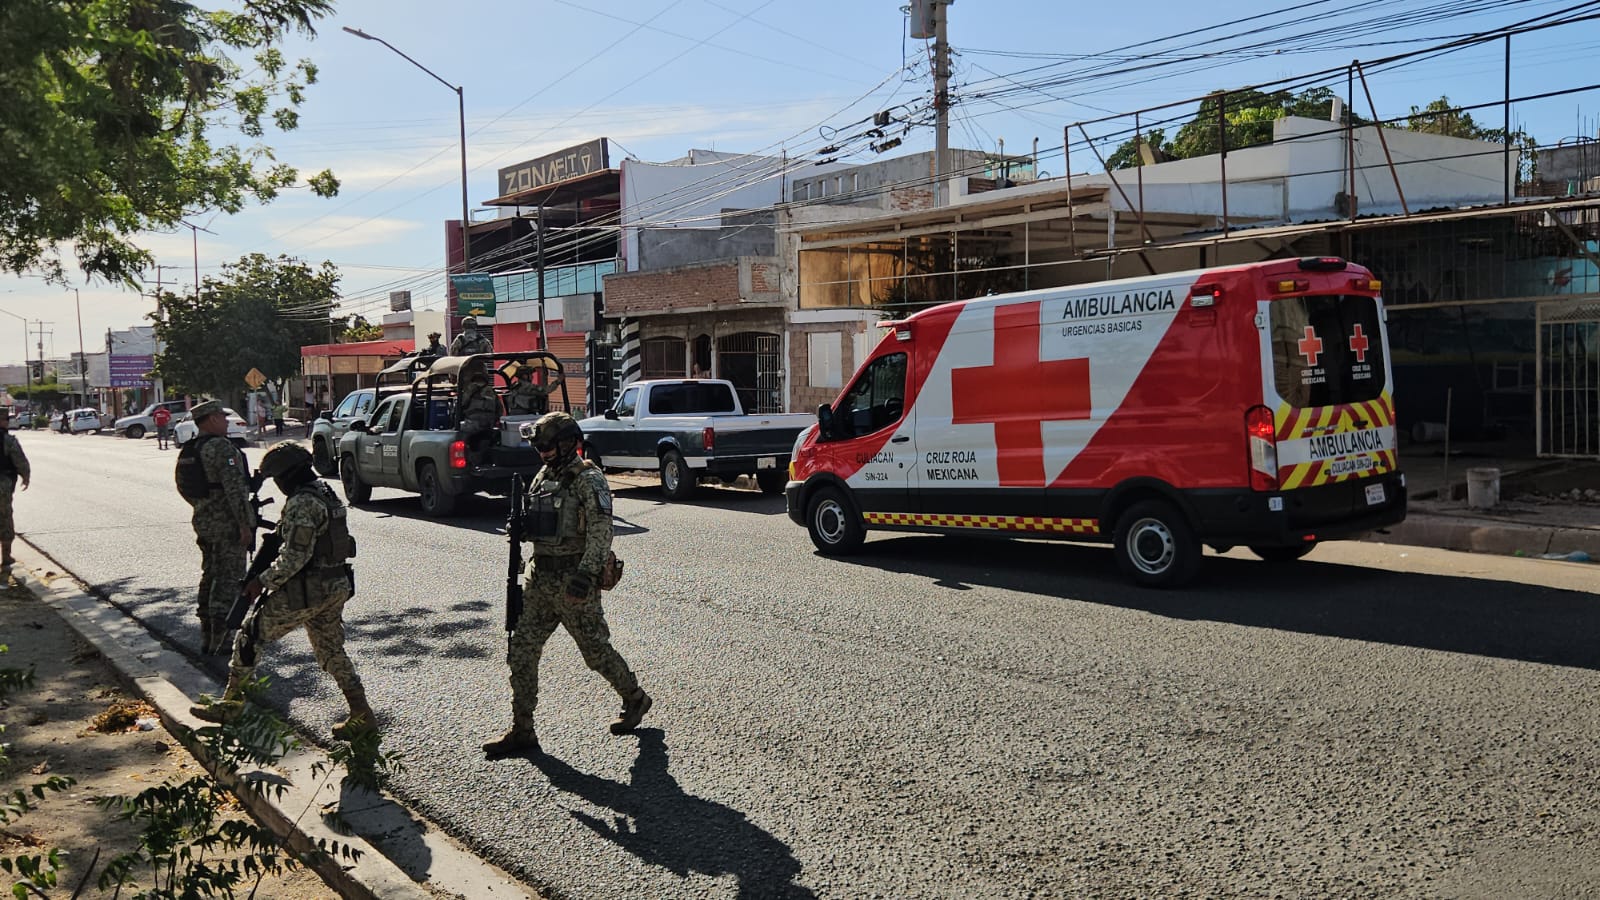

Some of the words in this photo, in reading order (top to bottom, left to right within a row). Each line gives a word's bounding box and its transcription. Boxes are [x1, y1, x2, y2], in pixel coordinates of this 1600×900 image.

[1062, 289, 1176, 320] AMBULANCIA
[1062, 323, 1106, 337] URGENCIAS
[1107, 320, 1142, 334] BASICAS
[1309, 429, 1384, 459] AMBULANCIA
[856, 451, 894, 464] CULIACAN
[926, 451, 950, 464] CRUZ
[952, 451, 977, 463] ROJA
[865, 472, 889, 481] SIN-224
[926, 468, 979, 480] MEXICANA
